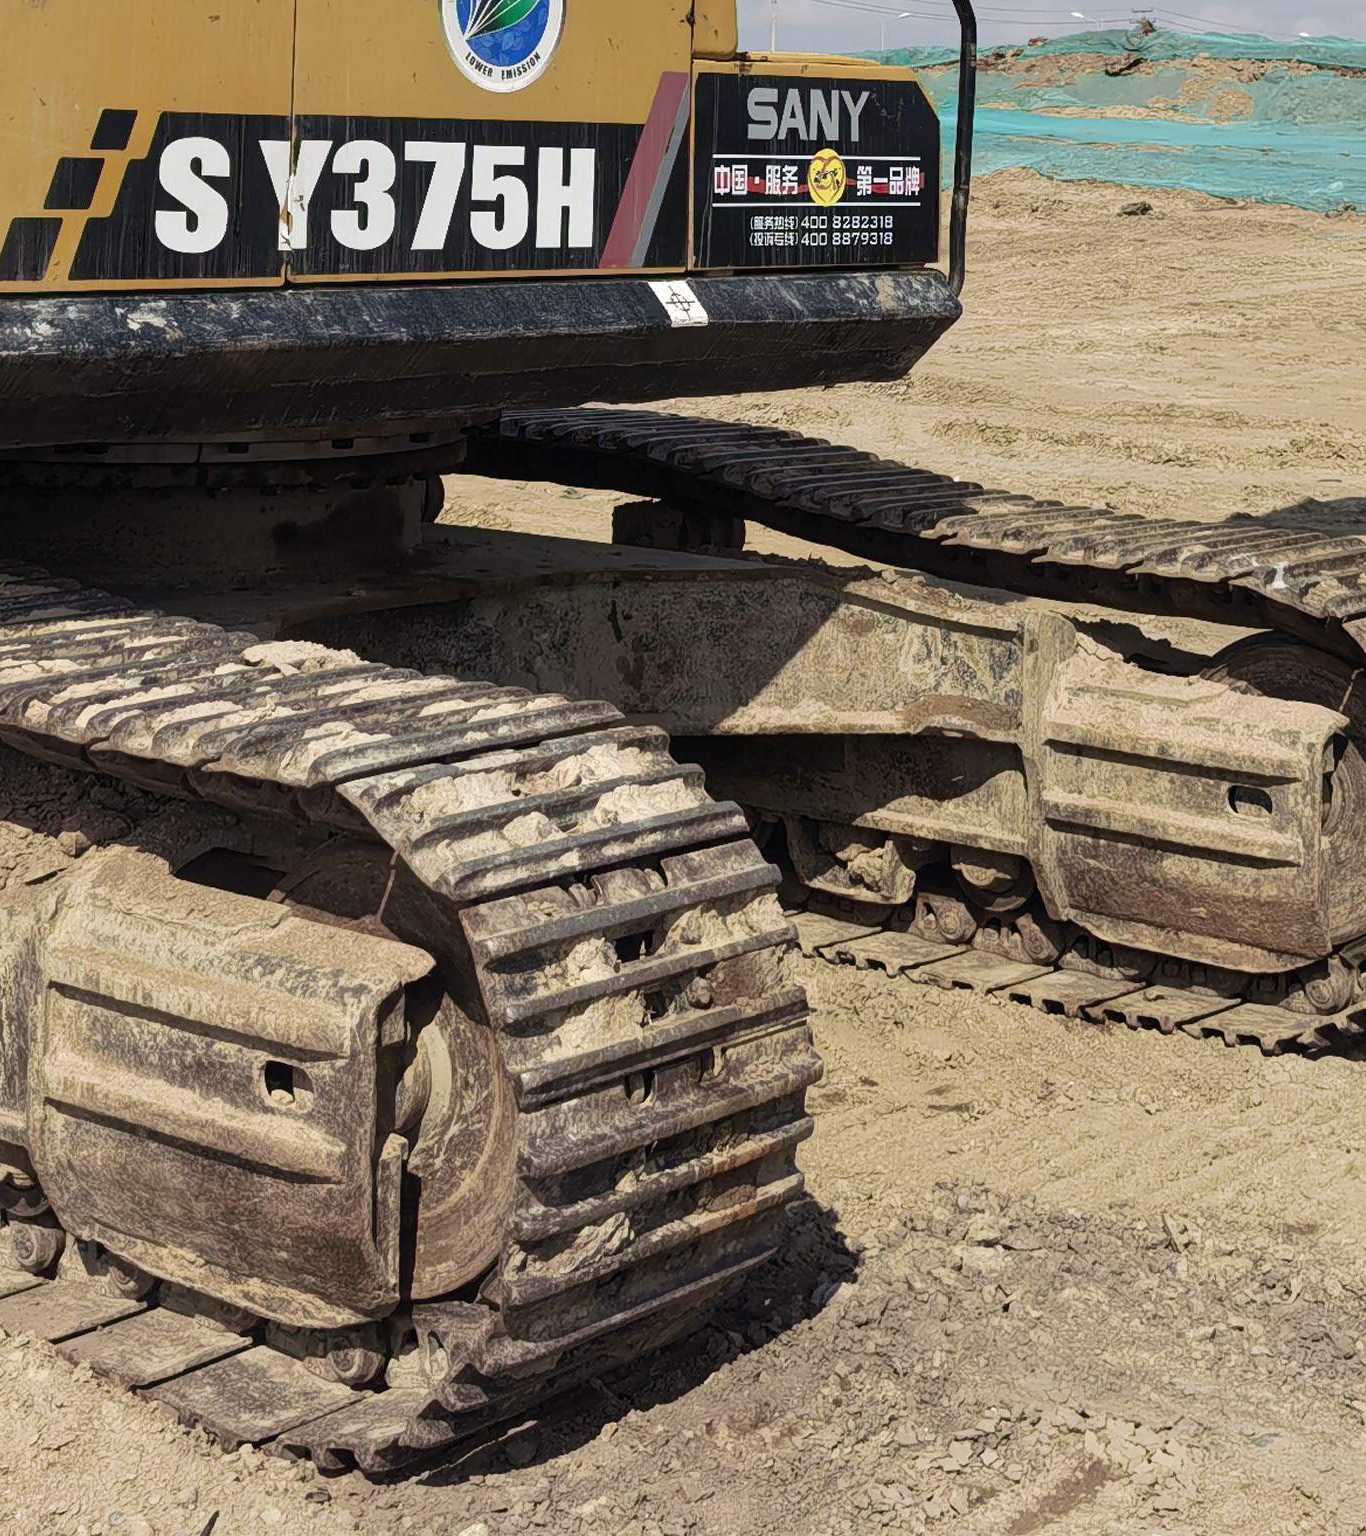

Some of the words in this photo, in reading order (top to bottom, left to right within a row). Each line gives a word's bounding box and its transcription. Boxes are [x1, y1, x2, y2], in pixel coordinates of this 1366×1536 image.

[465, 51, 494, 78] LOWER
[501, 51, 542, 81] EMISSION
[746, 87, 870, 142] SANY
[856, 165, 921, 196] 第一品牌
[800, 215, 828, 229] 400
[832, 214, 894, 229] 8282318
[800, 231, 828, 246] 400
[832, 231, 894, 246] 8879318
